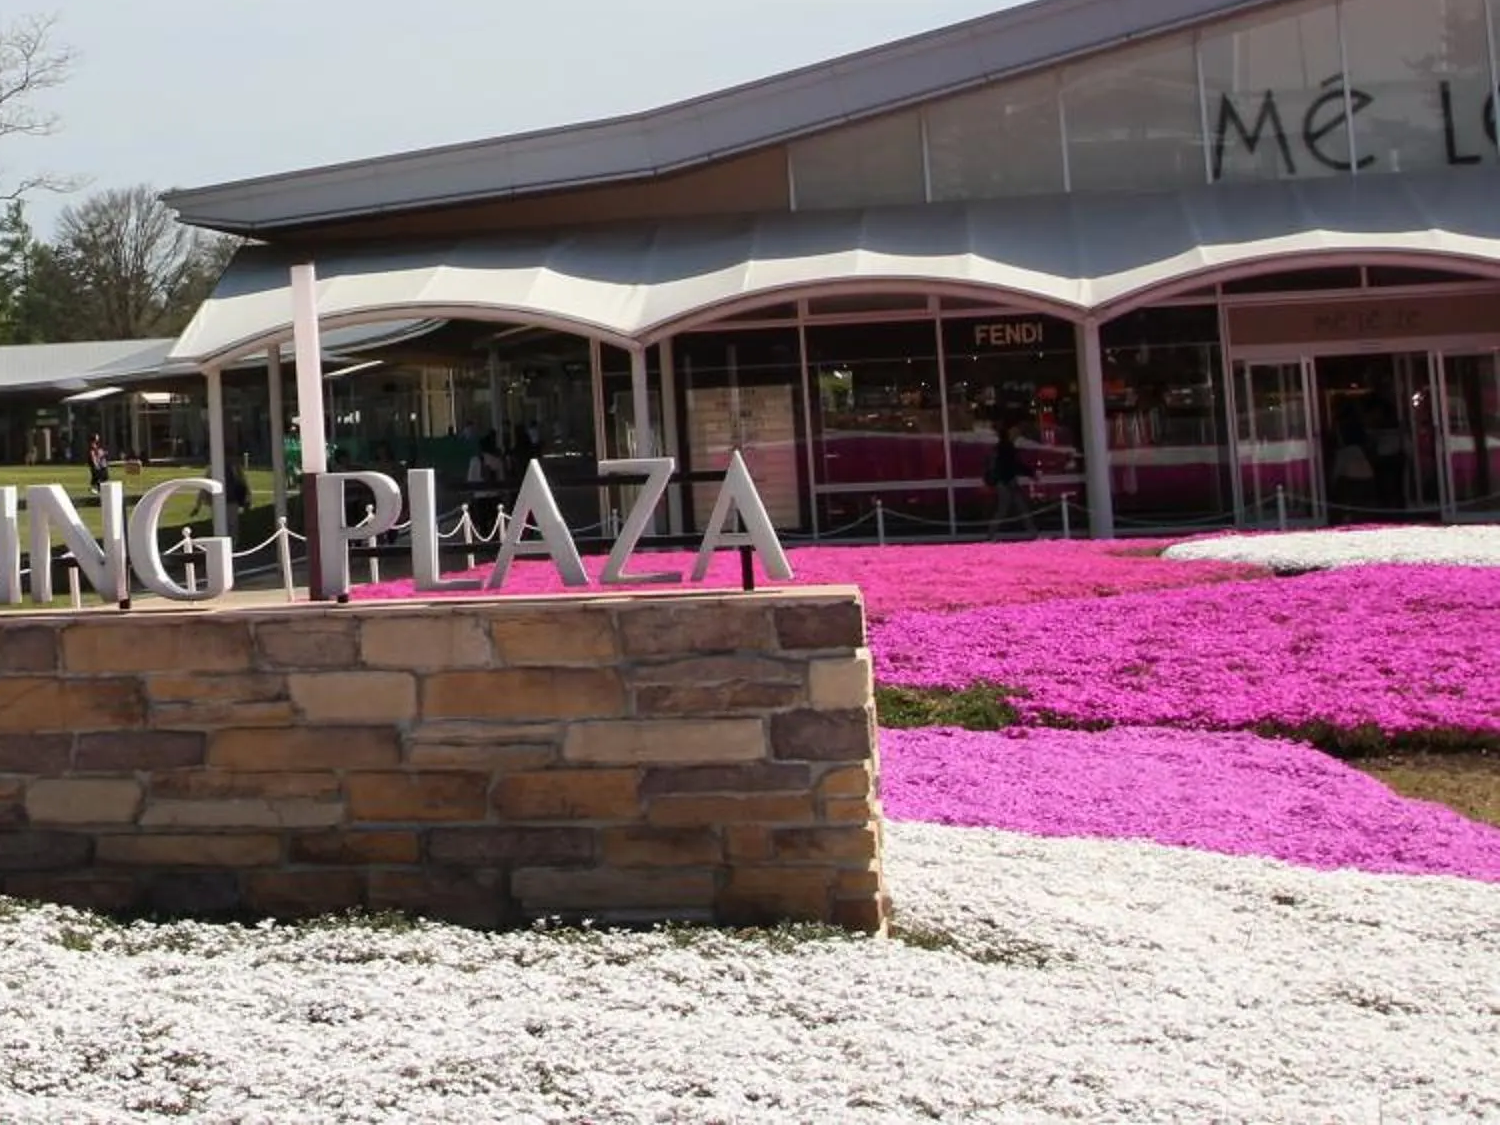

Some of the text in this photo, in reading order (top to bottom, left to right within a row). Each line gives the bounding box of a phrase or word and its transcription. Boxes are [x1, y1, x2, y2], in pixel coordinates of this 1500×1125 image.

[1439, 80, 1500, 165] L
[974, 321, 1043, 346] FENDI
[317, 449, 795, 597] PLAZA
